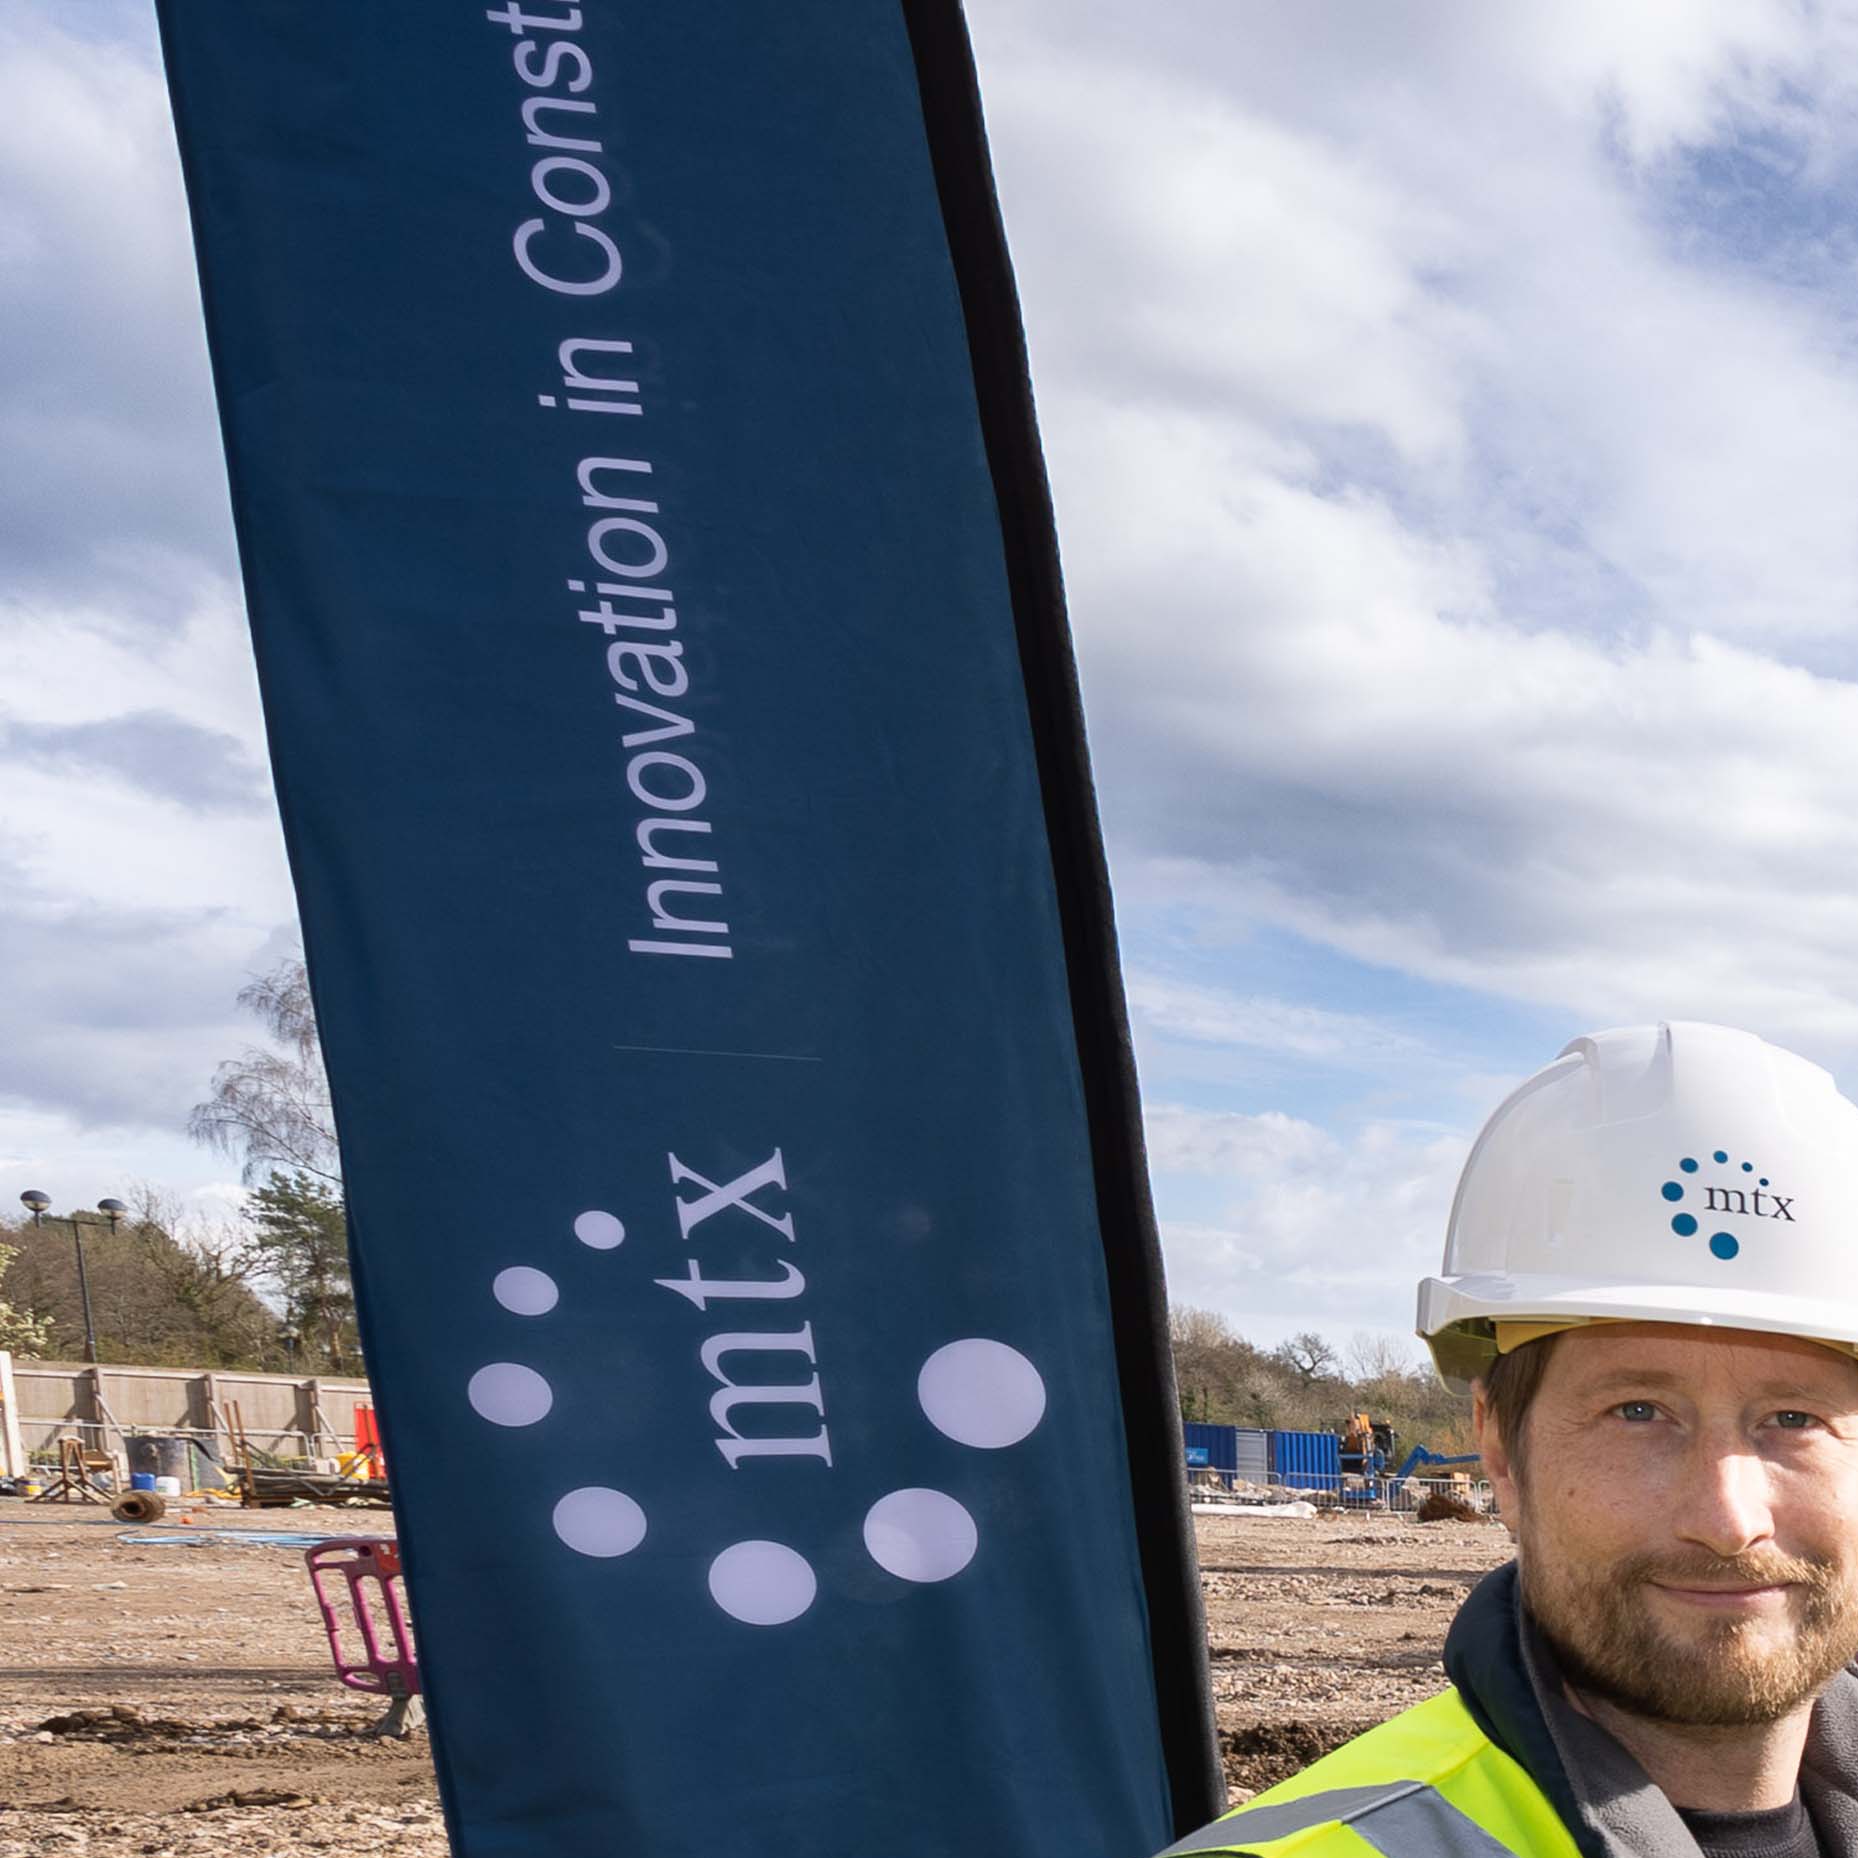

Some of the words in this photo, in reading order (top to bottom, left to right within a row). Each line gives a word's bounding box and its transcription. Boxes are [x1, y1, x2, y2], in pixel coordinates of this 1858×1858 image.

[486, 0, 622, 295] Const
[538, 338, 642, 416] in
[568, 460, 732, 959] Innovation
[653, 1147, 832, 1469] mtx
[1703, 1182, 1797, 1223] mtx
